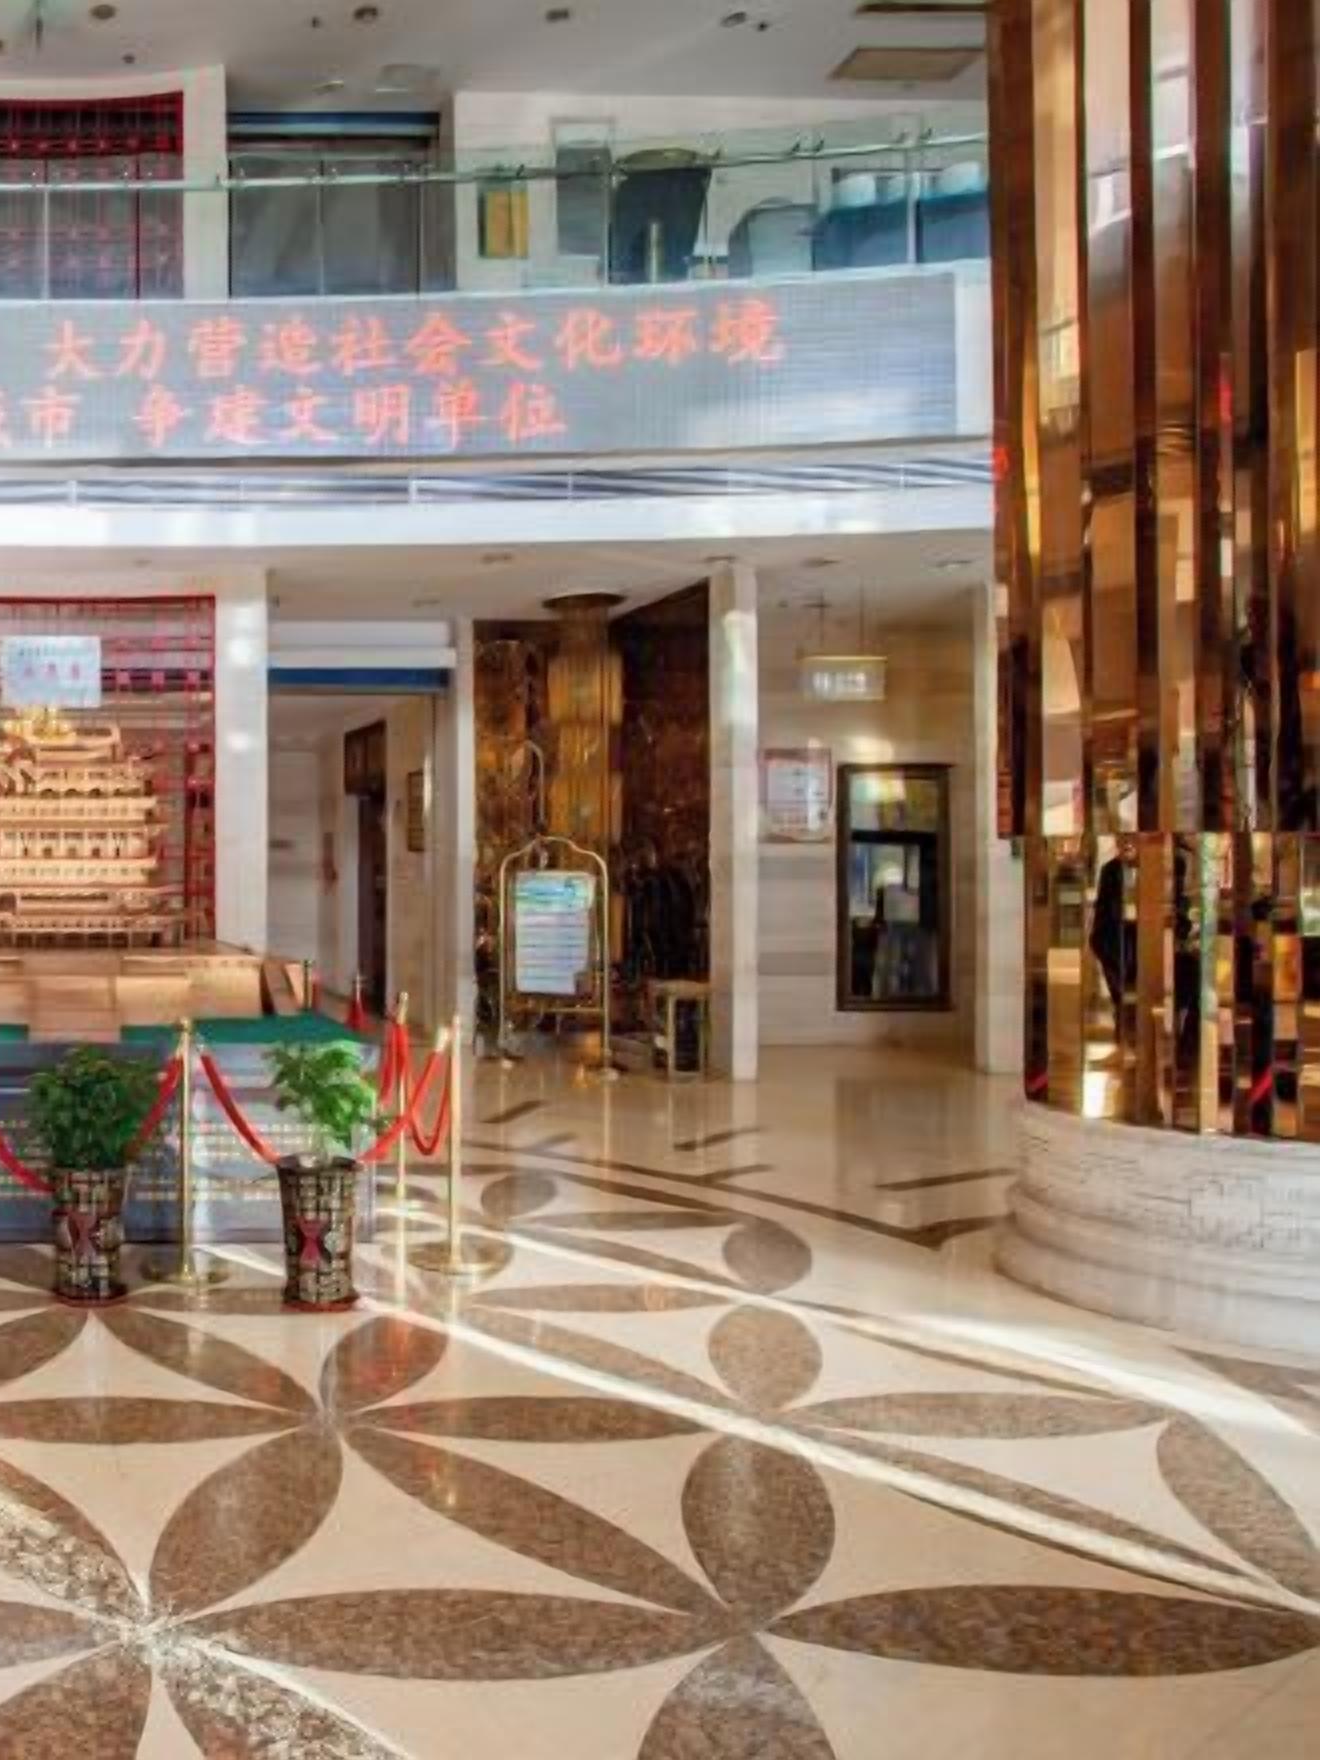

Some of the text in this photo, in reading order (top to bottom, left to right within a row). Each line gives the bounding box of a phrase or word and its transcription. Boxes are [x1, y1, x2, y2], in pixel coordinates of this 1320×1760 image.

[44, 300, 785, 380] 大力营造社会文化环境
[130, 380, 568, 447] 争建文明单位
